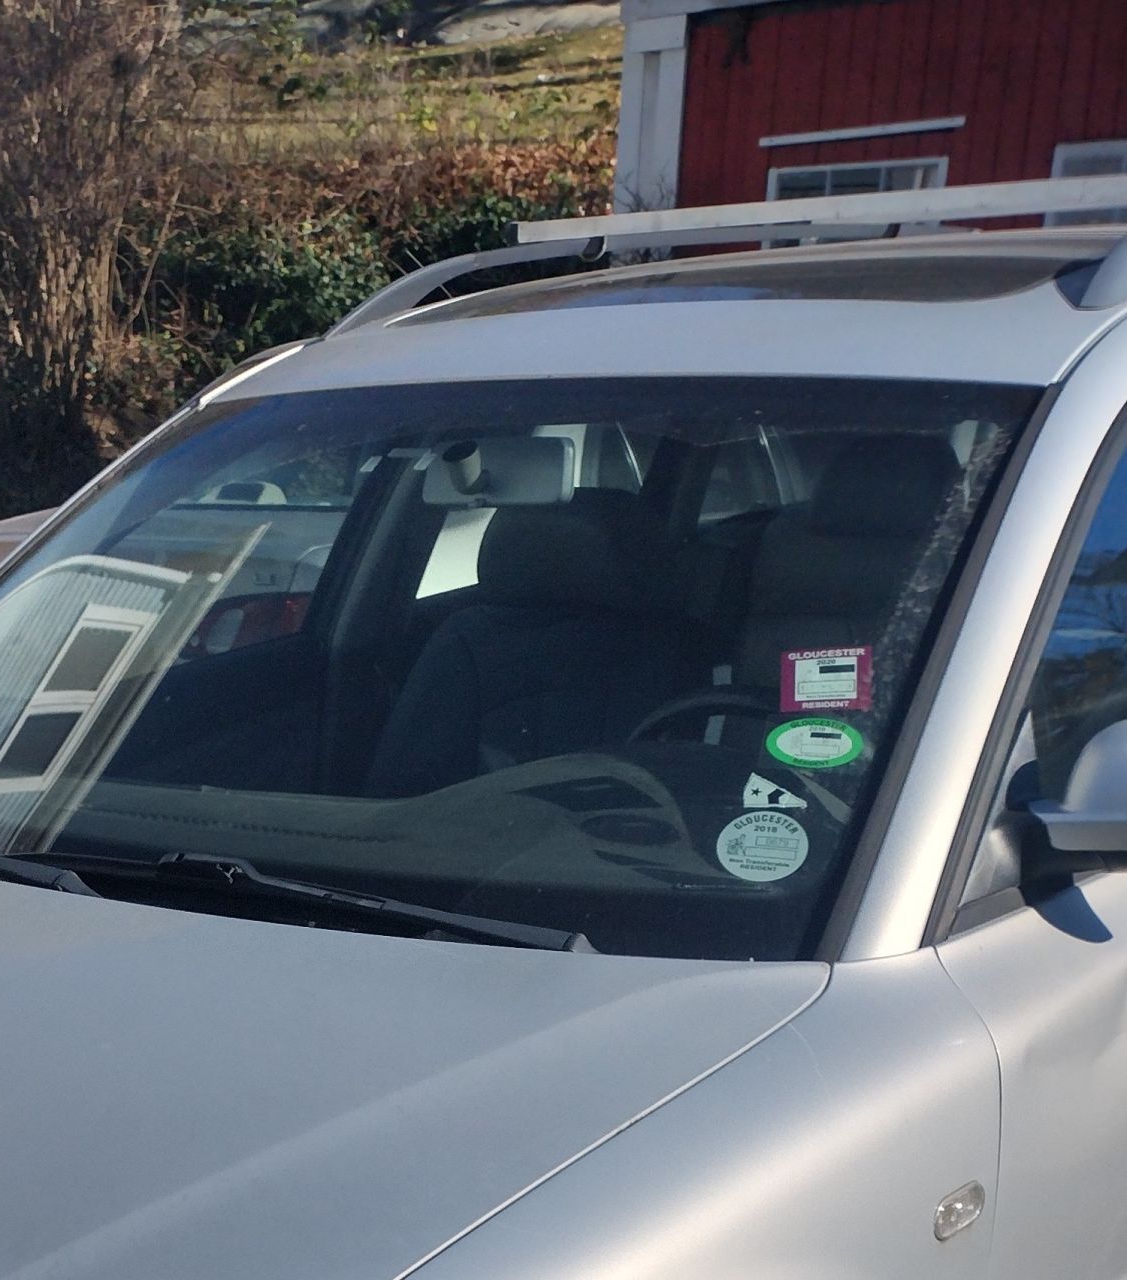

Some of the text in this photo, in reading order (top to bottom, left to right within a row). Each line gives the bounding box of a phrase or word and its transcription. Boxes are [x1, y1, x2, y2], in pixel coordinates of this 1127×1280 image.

[788, 648, 865, 660] GLOUCESTER
[802, 701, 849, 709] RESIDENT
[790, 720, 847, 731] GLOUCESTER
[734, 815, 799, 834] GLOUCESTER
